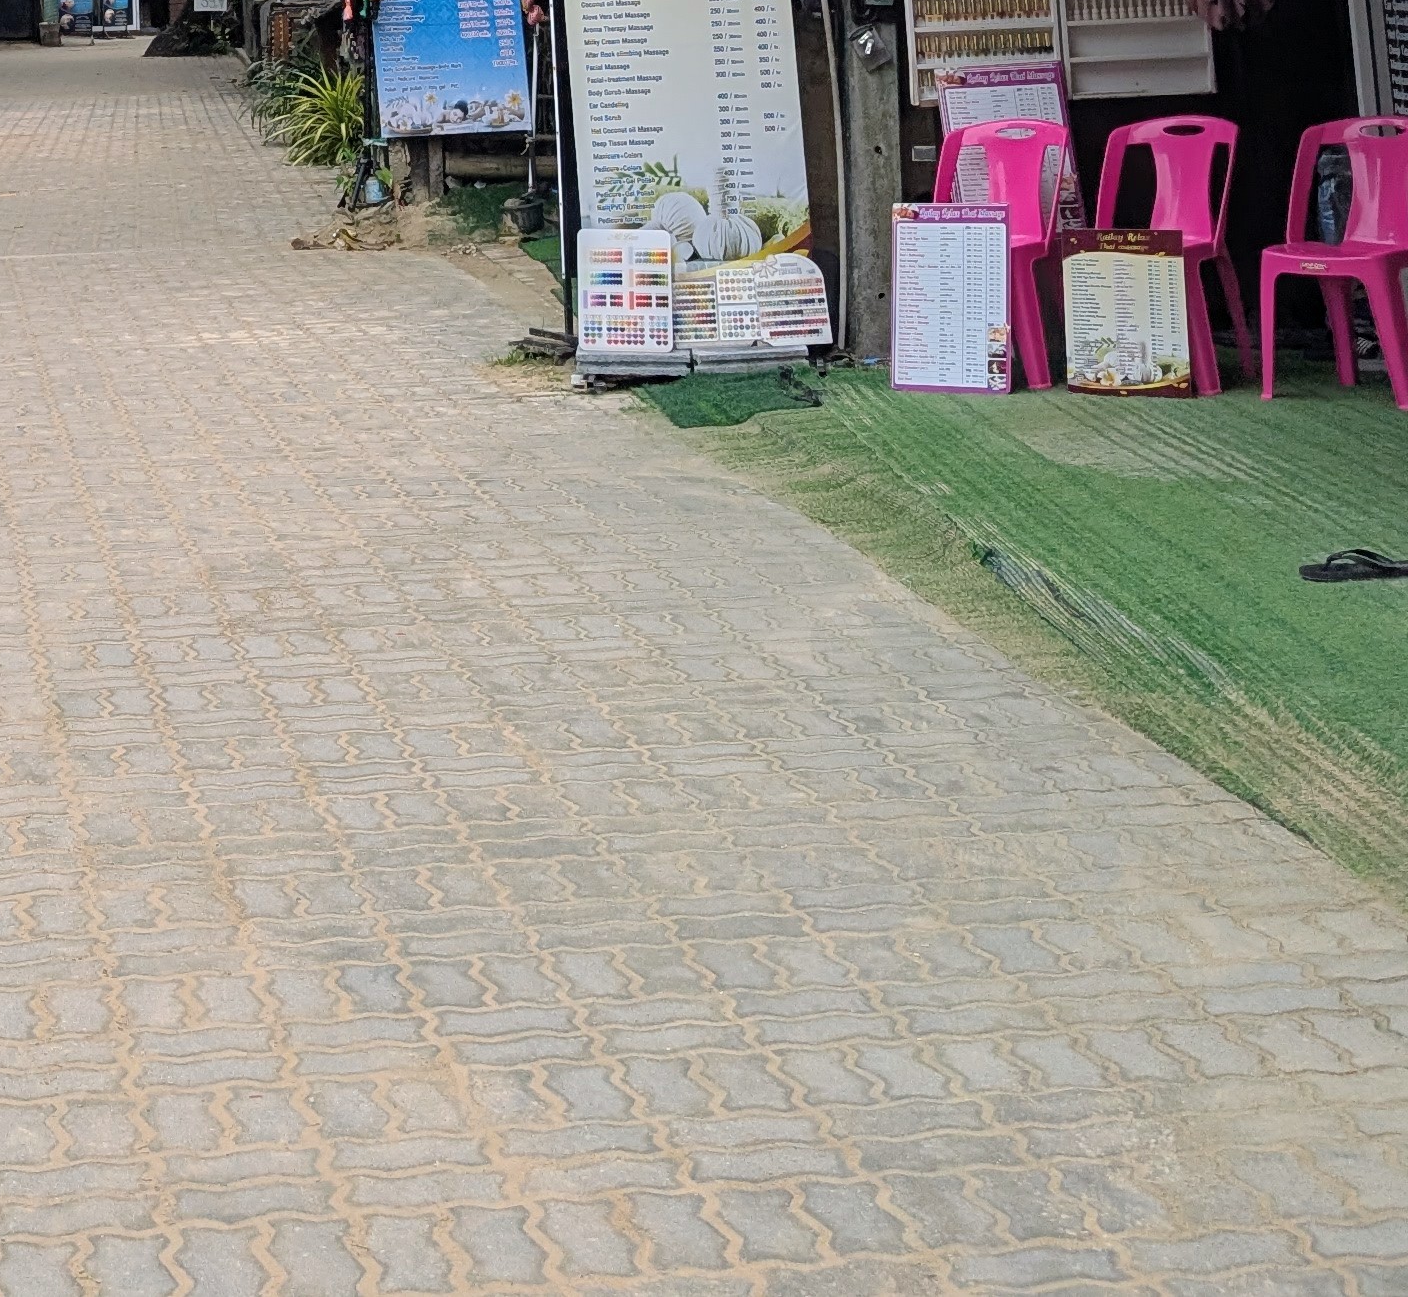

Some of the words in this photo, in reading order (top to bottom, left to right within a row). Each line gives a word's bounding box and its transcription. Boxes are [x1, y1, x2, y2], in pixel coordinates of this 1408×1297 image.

[615, 0, 641, 7] Massage
[624, 11, 650, 19] Massage
[604, 63, 630, 71] Massage
[636, 74, 662, 82] Massage
[637, 125, 663, 133] Massage
[1097, 232, 1125, 244] Railay
[1127, 232, 1151, 243] Relax
